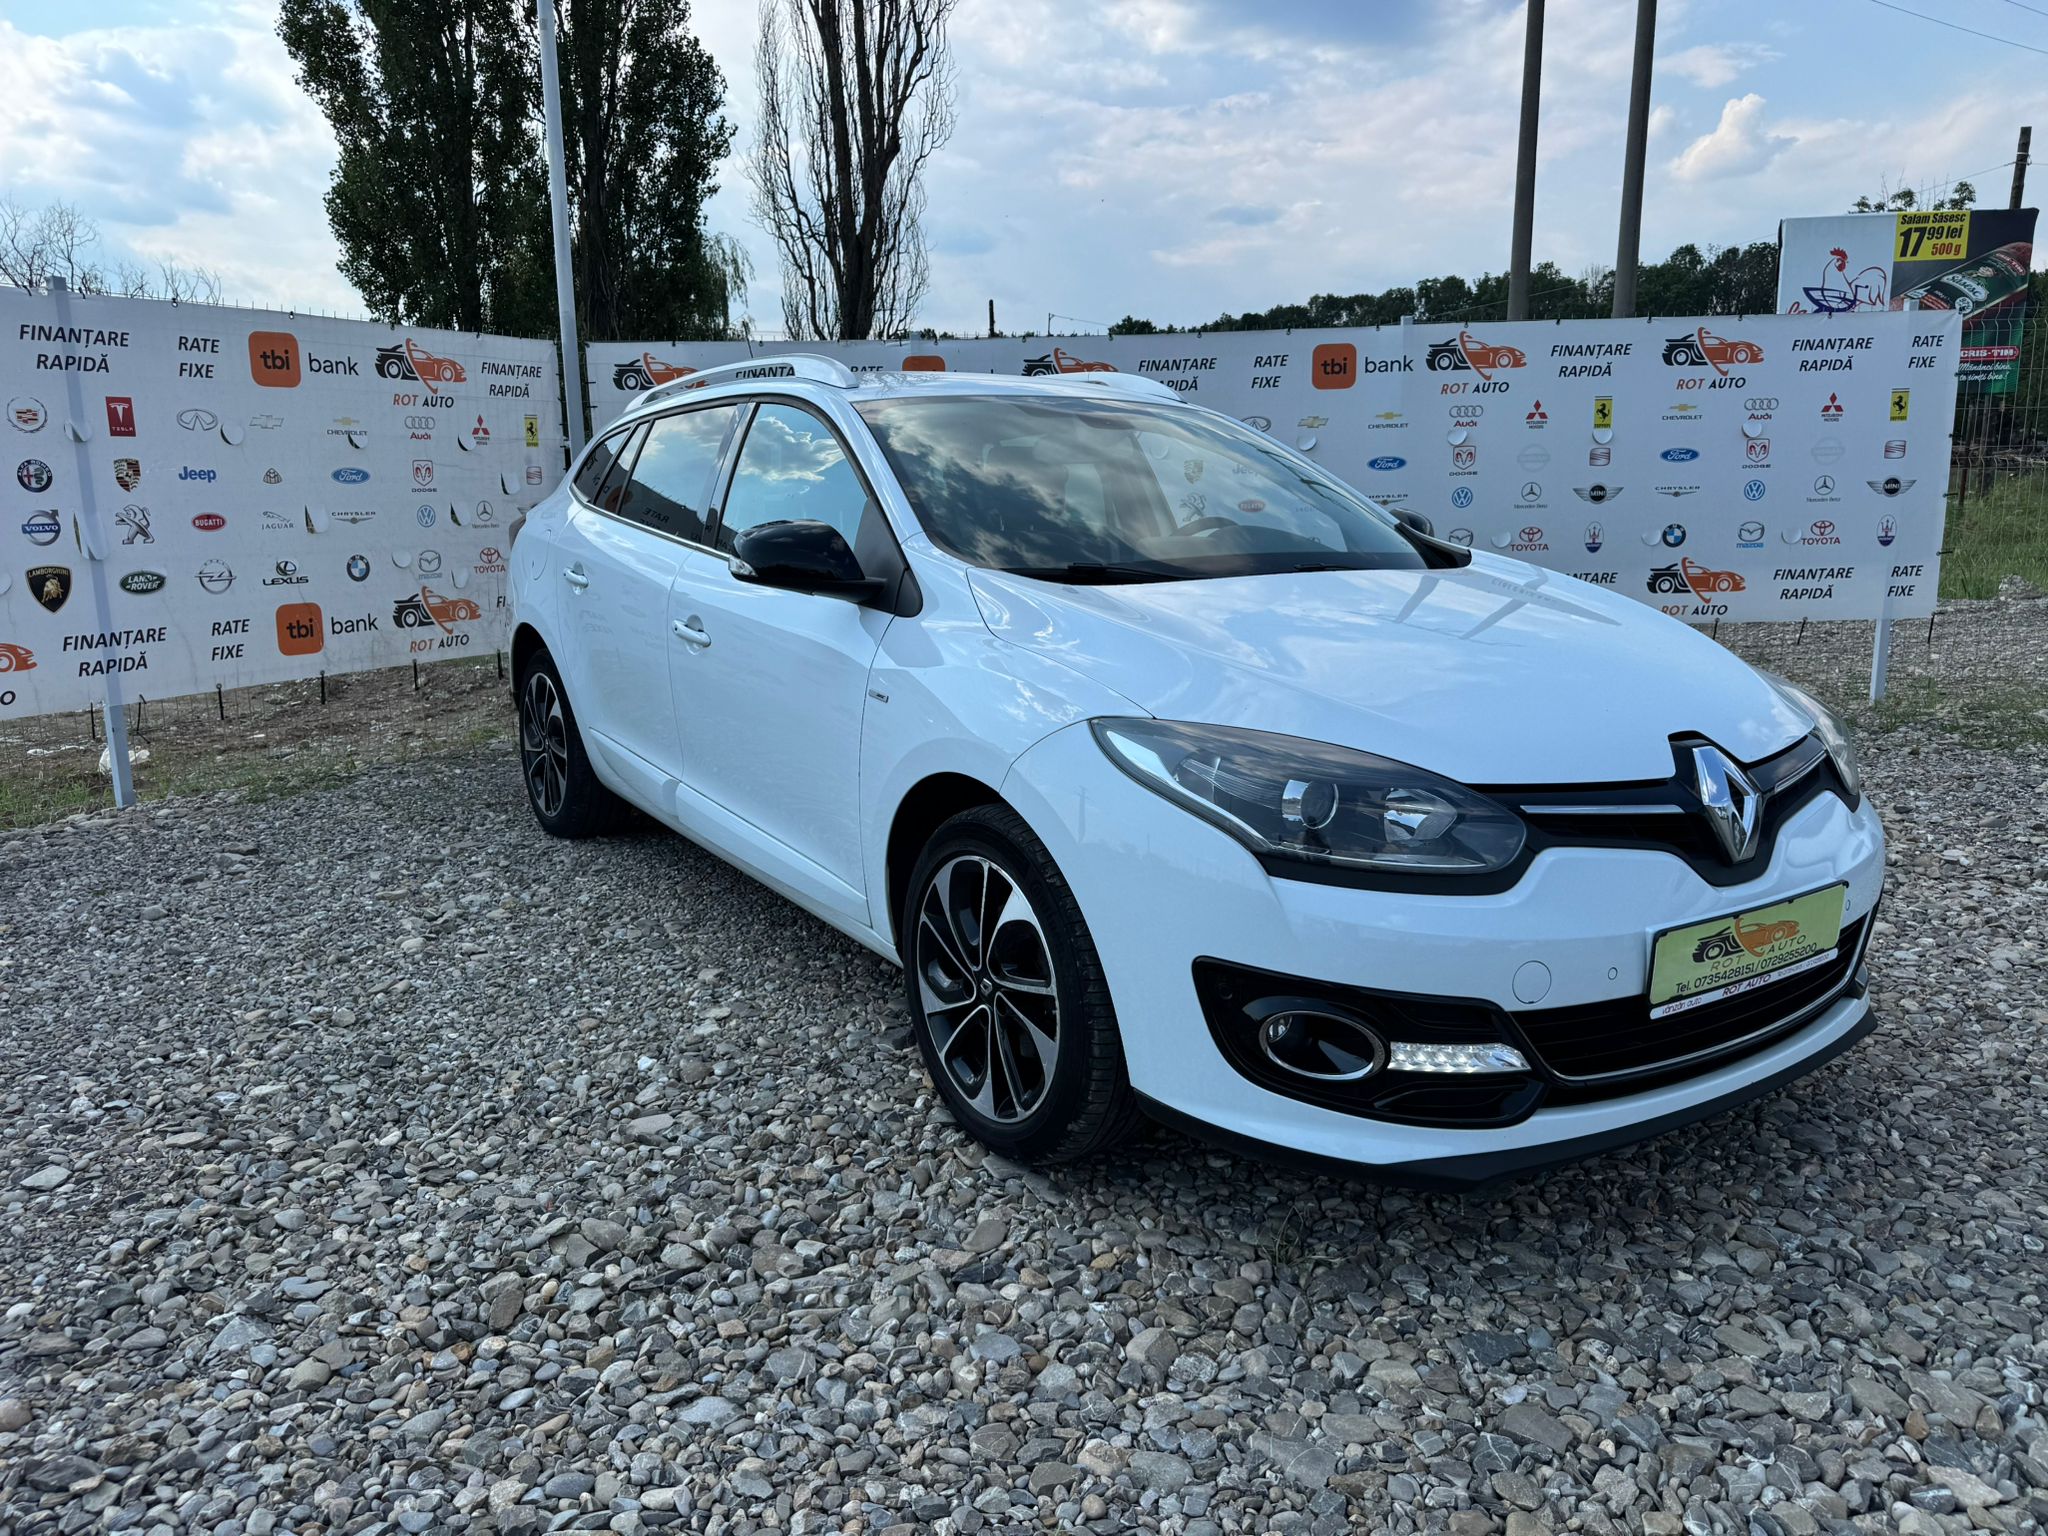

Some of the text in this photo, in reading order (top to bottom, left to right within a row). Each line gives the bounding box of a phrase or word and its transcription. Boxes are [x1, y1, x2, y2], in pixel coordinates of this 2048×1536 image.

[1901, 214, 1930, 224] Salam
[1899, 225, 1963, 257] 17 99 lei
[1931, 243, 1961, 255] 500 g
[19, 324, 130, 347] FINANȚARE
[1911, 335, 1944, 348] RATE
[178, 336, 220, 353] RATE
[1551, 343, 1632, 359] FINANȚARE
[1792, 337, 1874, 353] FINANȚARE
[36, 353, 110, 373] RAPIDĂ
[260, 350, 359, 375] tbi bank
[1138, 358, 1217, 374] FINANȚARE
[1253, 354, 1289, 368] RATE
[1321, 355, 1414, 375] tbi bank
[1799, 356, 1853, 372] RAPIDĂ
[1908, 356, 1936, 369] FIXE
[179, 362, 214, 379] FIXE
[481, 362, 542, 378] FINANȚARE
[1558, 362, 1612, 378] RAPIDĂ
[1251, 376, 1281, 389] FIXE
[1441, 381, 1510, 395] ROT AUTO
[1676, 377, 1746, 390] ROT AUTO
[489, 384, 529, 398] RAPIDĂ
[393, 394, 454, 408] ROT AUTO
[327, 429, 368, 437] CHEVROLET
[410, 432, 431, 440] Audi
[1374, 458, 1400, 468] Ford
[1667, 451, 1692, 461] Ford
[178, 466, 216, 484] Jeep
[338, 469, 363, 481] Ford
[24, 523, 58, 532] VOLVO
[194, 518, 223, 527] BUGATTI
[261, 522, 294, 530] JAGUAR
[1510, 543, 1550, 552] TOYOTA
[1801, 537, 1841, 546] TOYOTA
[28, 567, 69, 579] LAMBORGHINI
[474, 565, 506, 574] TOYOTA
[1773, 567, 1854, 583] FINANȚARE
[1891, 565, 1923, 578] RATE
[262, 575, 309, 586] LEXUS
[1780, 585, 1834, 600] RAPIDĂ
[1888, 585, 1915, 597] FIXE
[1662, 605, 1728, 616] ROT AUTO
[211, 619, 250, 636] RATE
[286, 613, 379, 639] tbi bank
[63, 627, 167, 652] FINANȚARE
[409, 634, 469, 653] ROT AUTO
[211, 644, 244, 661] FIXE
[78, 652, 148, 677] RAPIDĂ
[1710, 935, 1807, 971] ROT AUTO
[1675, 981, 1692, 993] Tel.
[1722, 973, 1772, 998] ROT AUTO
